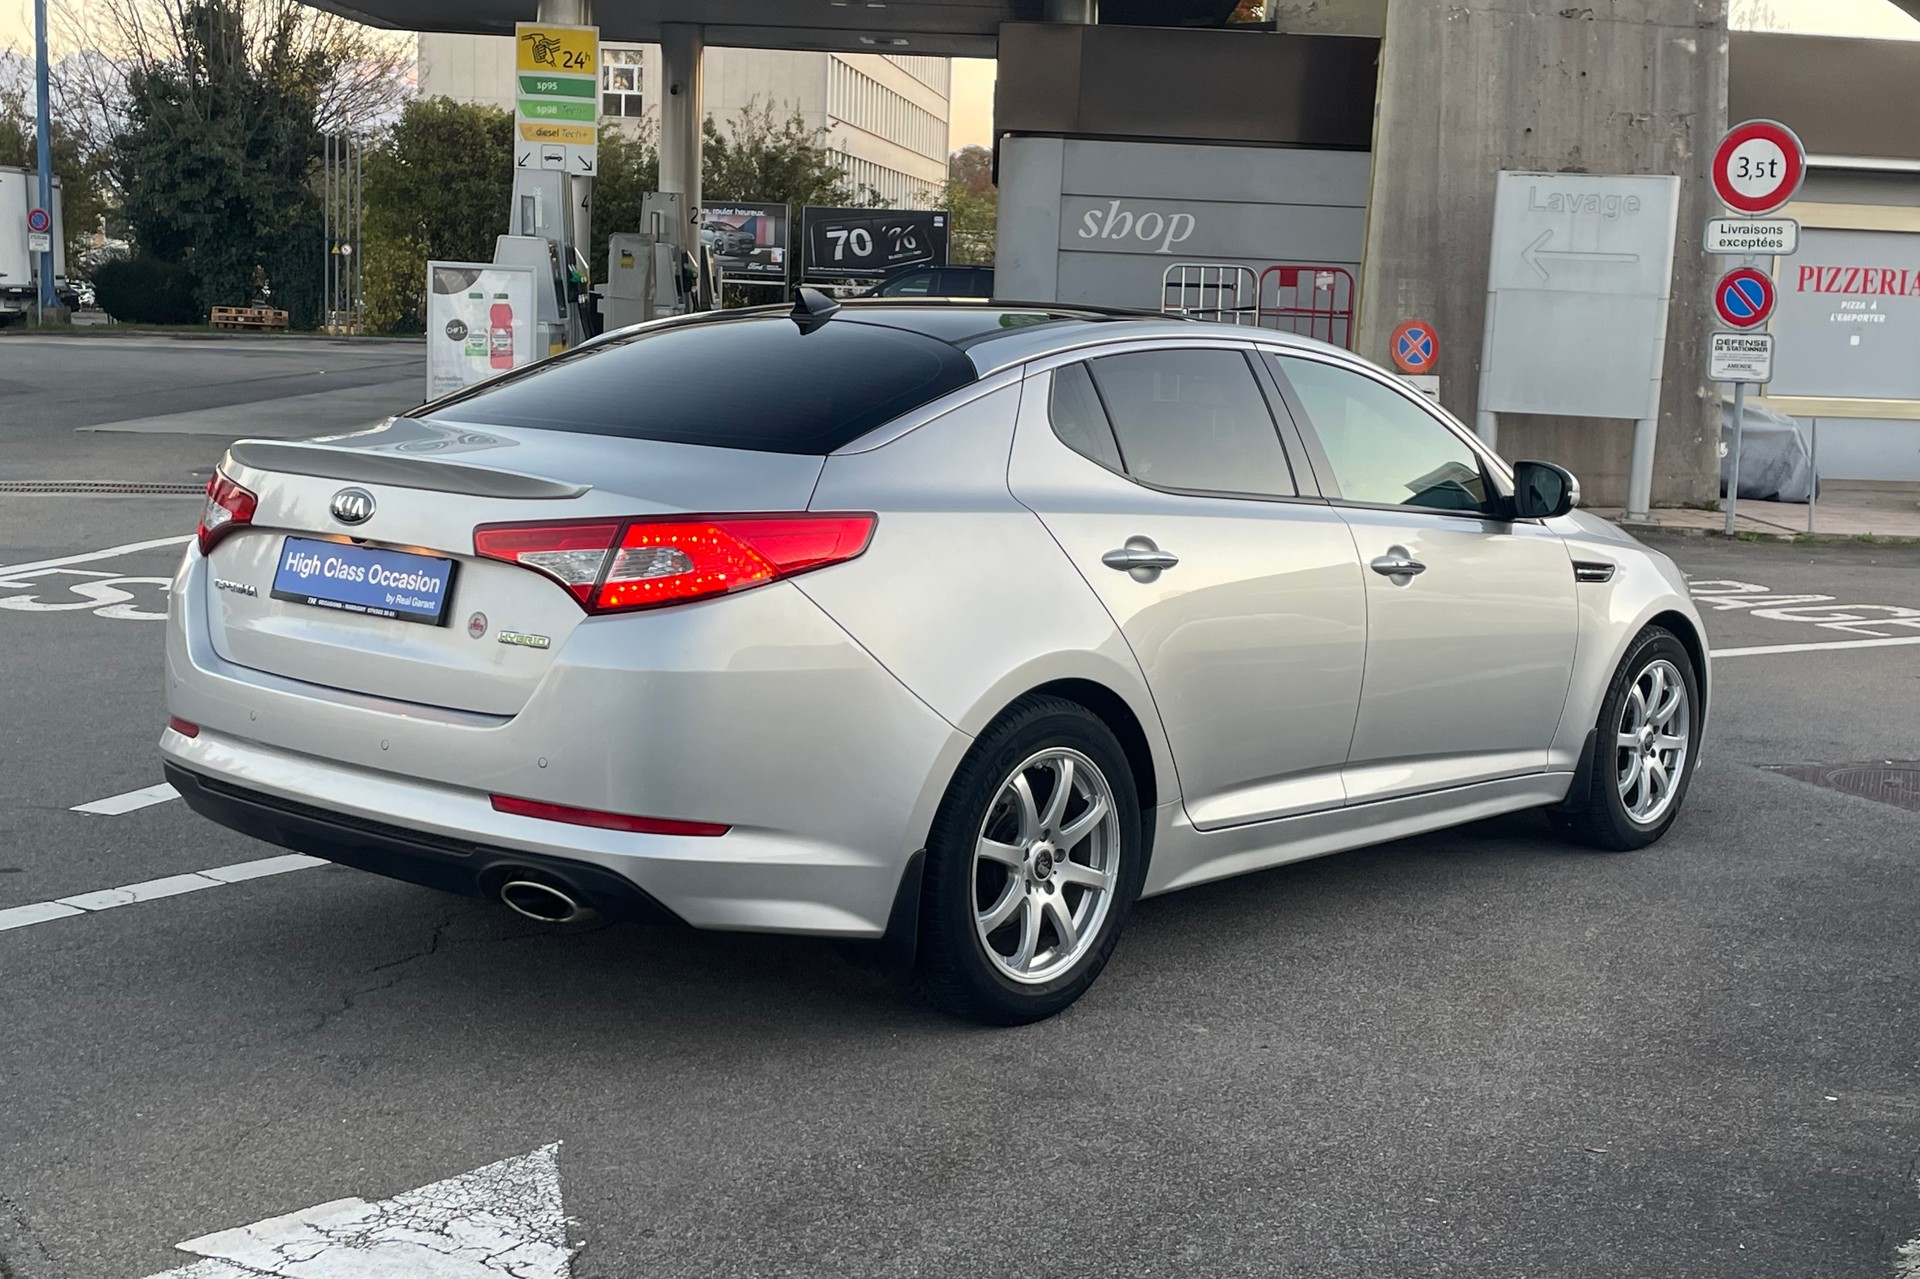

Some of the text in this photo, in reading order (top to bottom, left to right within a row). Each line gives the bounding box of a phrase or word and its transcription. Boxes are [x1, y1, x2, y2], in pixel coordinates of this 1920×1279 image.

[536, 82, 558, 92] sp95
[536, 106, 558, 116] sp98
[535, 127, 589, 139] diesel Tech+
[1736, 156, 1778, 181] 3,5 t
[581, 194, 590, 213] 4
[712, 207, 734, 216] rouler
[1528, 186, 1641, 221] Lavage
[690, 207, 699, 225] 2
[1078, 200, 1196, 254] shop
[1720, 223, 1784, 235] Livraisons
[826, 228, 874, 261] 70
[1719, 236, 1784, 250] exceptées
[1797, 265, 1920, 297] PIZZERIA
[1840, 300, 1866, 310] PIZZA
[1830, 312, 1886, 324] L'EMPORTER
[334, 495, 366, 516] KIA
[285, 551, 441, 594] High Class Occasion
[385, 592, 436, 609] by Real Garant
[500, 632, 547, 646] HYBRID
